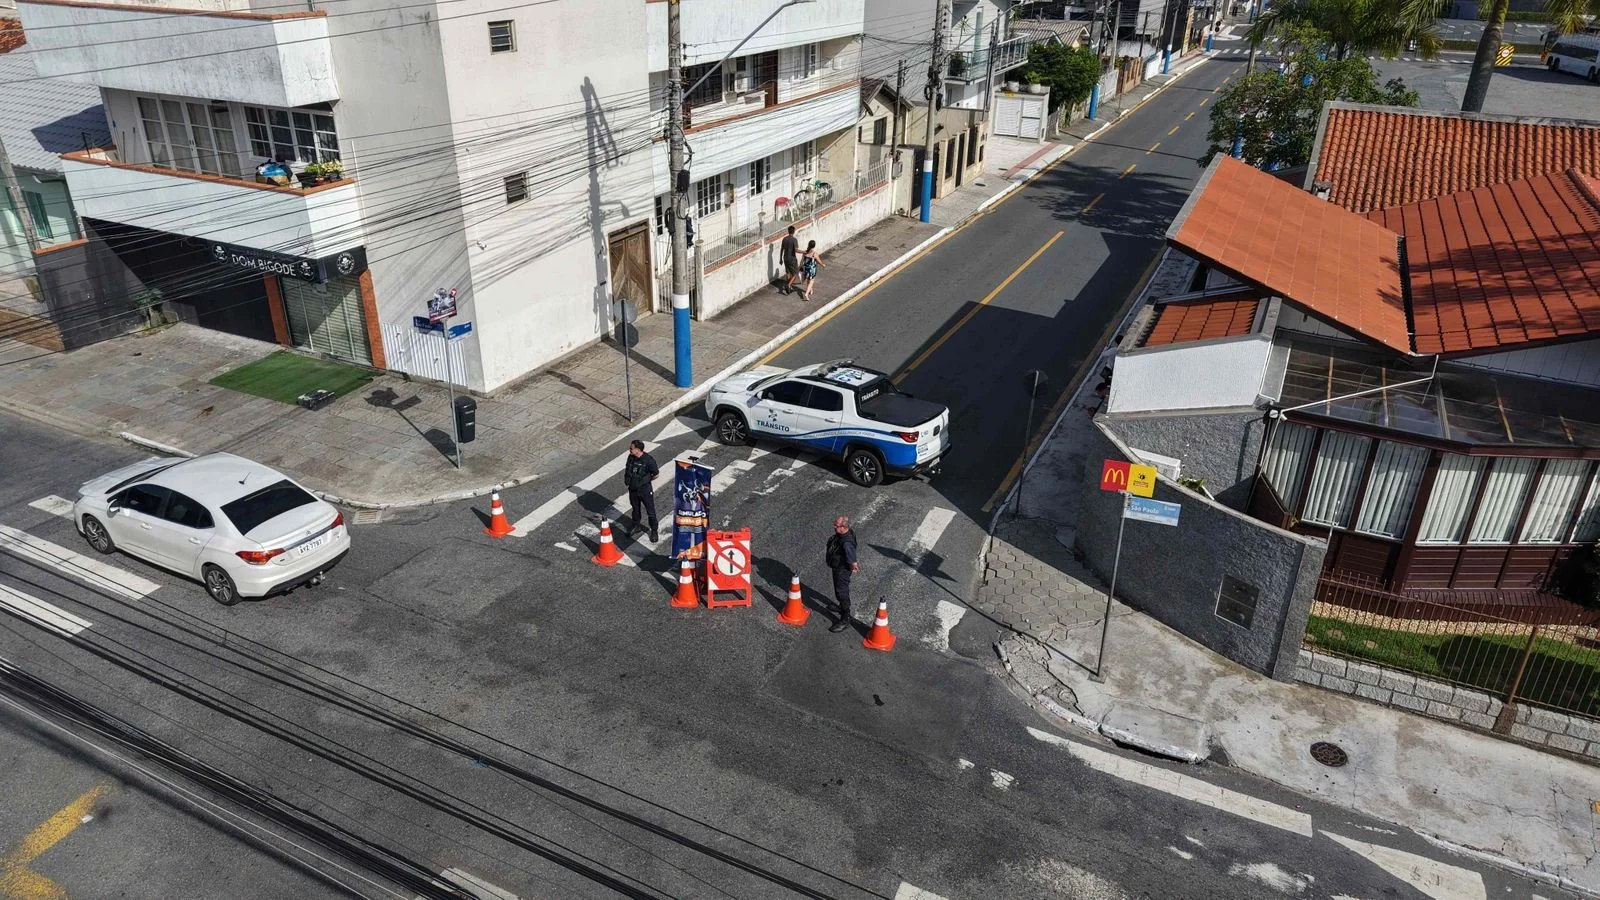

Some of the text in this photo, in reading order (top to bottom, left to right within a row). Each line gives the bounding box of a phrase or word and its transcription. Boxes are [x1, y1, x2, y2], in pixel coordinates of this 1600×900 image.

[231, 253, 296, 277] DOM BIGODE
[756, 419, 790, 433] TRÂNSITO
[1142, 506, 1160, 514] Paulo
